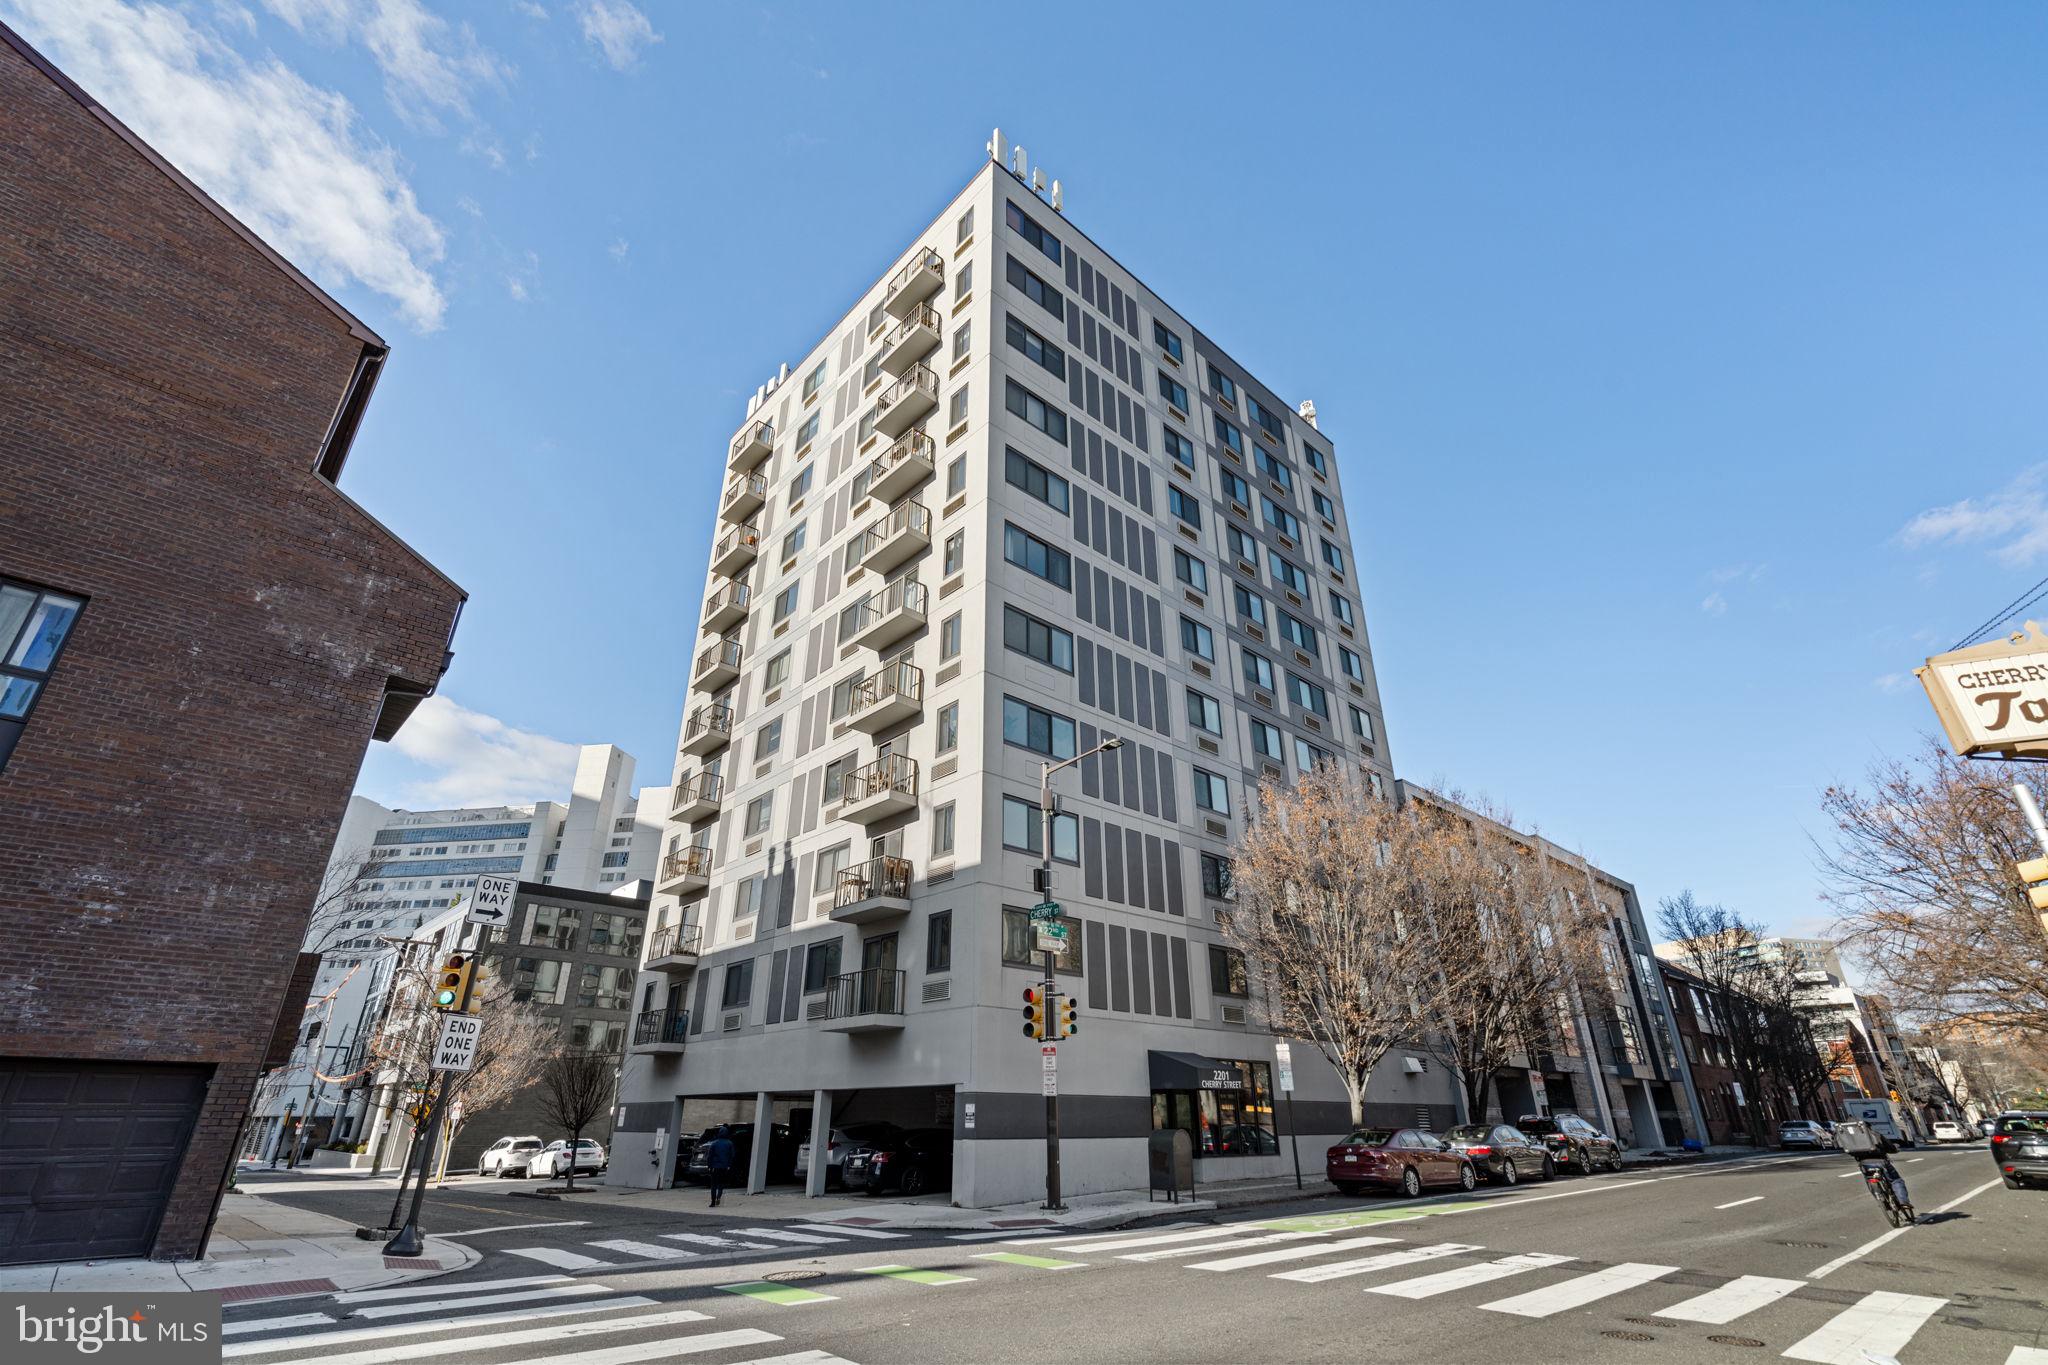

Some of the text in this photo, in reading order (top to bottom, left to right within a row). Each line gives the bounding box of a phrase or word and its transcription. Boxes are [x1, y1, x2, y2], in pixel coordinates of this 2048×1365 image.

[482, 879, 511, 894] ONE
[479, 891, 509, 906] WAY
[1030, 907, 1053, 920] CHERRY
[449, 1020, 476, 1035] END
[445, 1036, 473, 1051] ONE
[440, 1051, 469, 1066] WAY
[1213, 1070, 1230, 1081] 2201
[1201, 1079, 1242, 1089] CHERRY STREET
